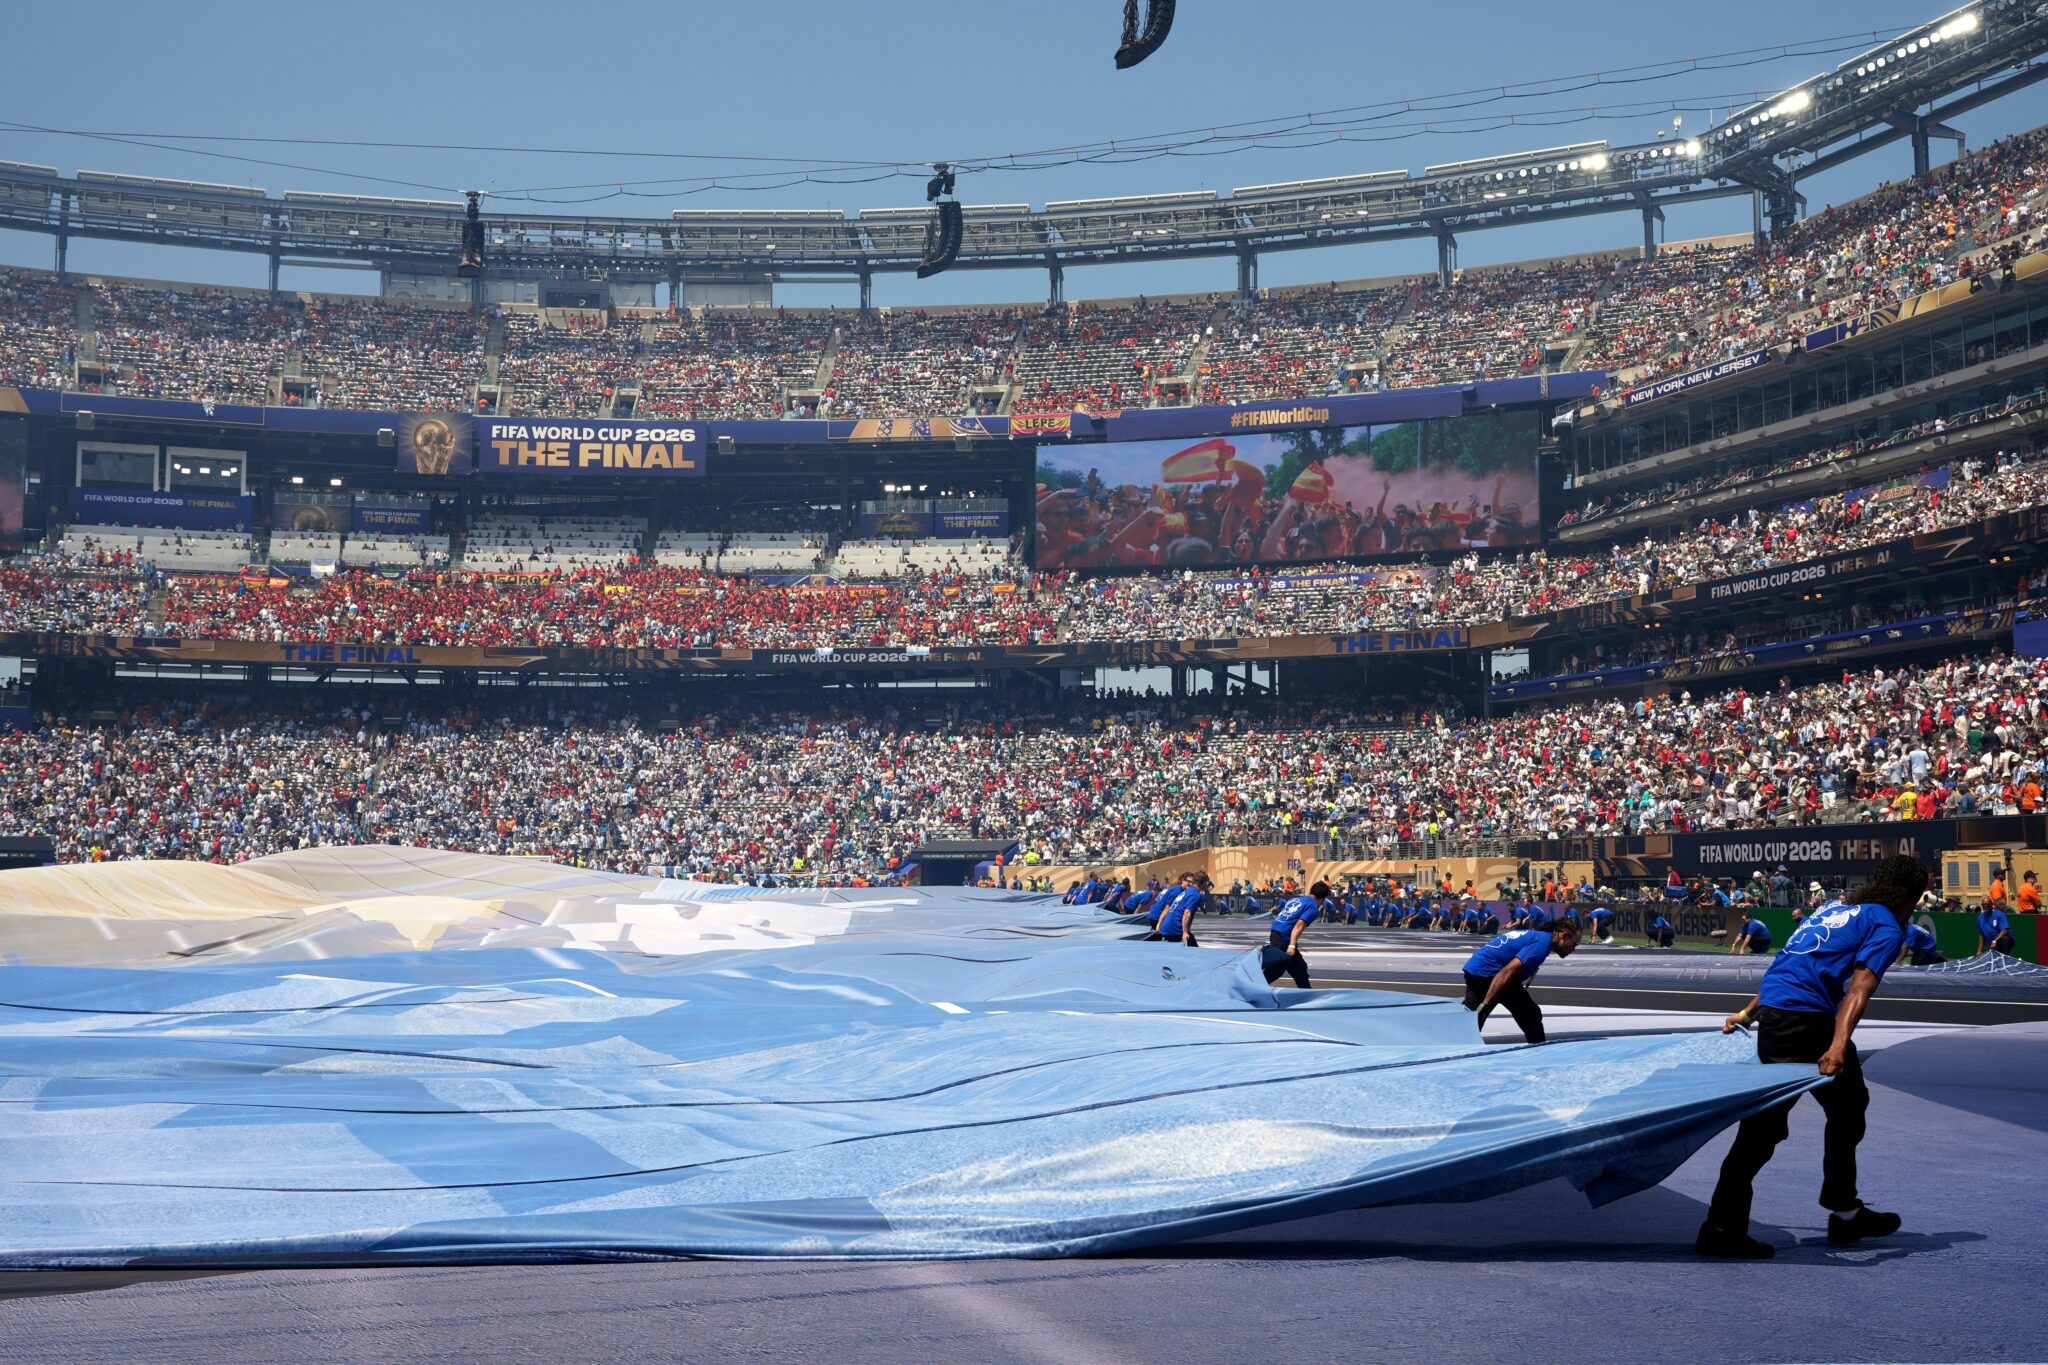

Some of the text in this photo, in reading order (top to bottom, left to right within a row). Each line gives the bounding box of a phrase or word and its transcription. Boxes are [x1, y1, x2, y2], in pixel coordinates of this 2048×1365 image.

[1630, 354, 1761, 402] NEW YORK NEW JERSEY
[1026, 418, 1056, 429] LEPE
[1230, 406, 1329, 428] #FIFAWorldCup
[492, 425, 696, 442] FIFA WORLD CUP 2026
[491, 440, 695, 469] THE FINAL
[207, 501, 238, 509] FINAL
[387, 516, 420, 524] FINAL
[1711, 585, 1732, 599] FIFA
[1732, 578, 1768, 594] WORLD
[1769, 573, 1790, 587] CUP
[1791, 564, 1826, 583] 2026
[1830, 559, 1854, 574] THE
[1331, 630, 1470, 653] THE FINAL
[280, 645, 421, 663] THE FINAL
[772, 654, 796, 663] FIFA
[799, 654, 840, 663] WORLD
[843, 654, 866, 663] CUP
[868, 653, 909, 662] 2026
[1700, 843, 1722, 863] FIFA
[1723, 842, 1763, 862] WORLD
[1764, 842, 1787, 862] CUP
[1789, 840, 1832, 861] 2026
[1837, 839, 1868, 860] THE
[1676, 913, 1727, 937] JERSEY
